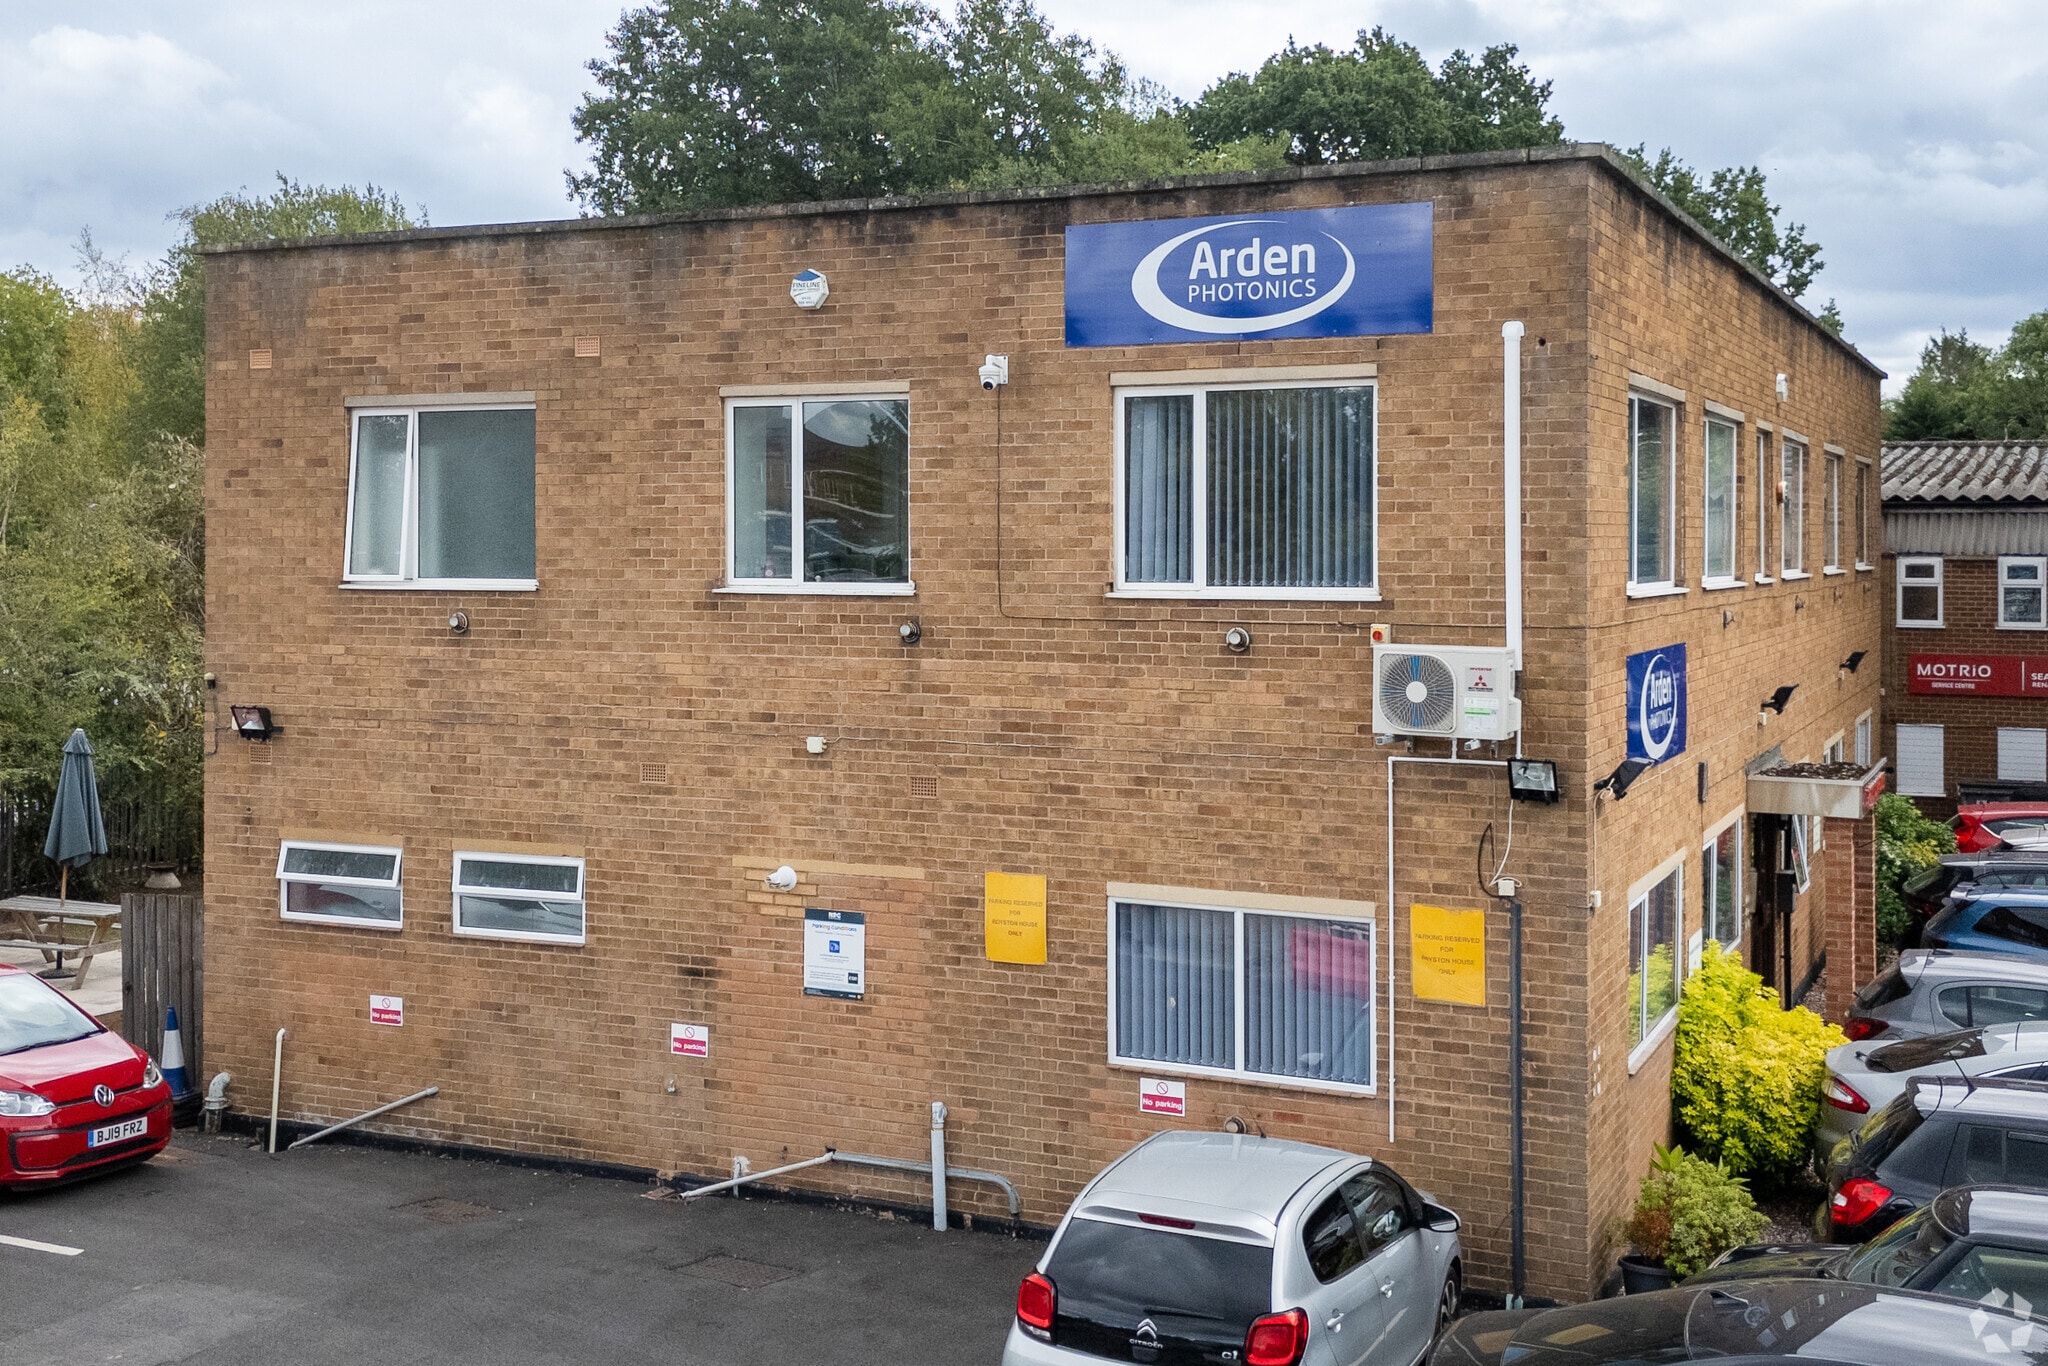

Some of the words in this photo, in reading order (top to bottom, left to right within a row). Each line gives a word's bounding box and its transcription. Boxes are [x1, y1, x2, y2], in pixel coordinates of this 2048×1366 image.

[1188, 237, 1316, 280] Arden
[792, 281, 821, 289] FINELINE
[1188, 278, 1317, 303] PHOTONICS
[1650, 670, 1672, 709] Arden
[1931, 681, 1954, 689] SERVICE
[988, 898, 1012, 906] PARKING
[1013, 900, 1043, 908] RESERVED
[1019, 920, 1039, 928] HOUSE
[1444, 935, 1480, 943] RESERVED
[1451, 957, 1475, 966] HOUSE
[372, 1011, 381, 1019] No
[381, 1013, 401, 1022] parking
[673, 1041, 683, 1049] No
[683, 1043, 706, 1053] parking
[1142, 1098, 1154, 1106] No
[1154, 1100, 1182, 1111] parking
[97, 1126, 121, 1143] BJ19
[123, 1120, 143, 1137] FRZ
